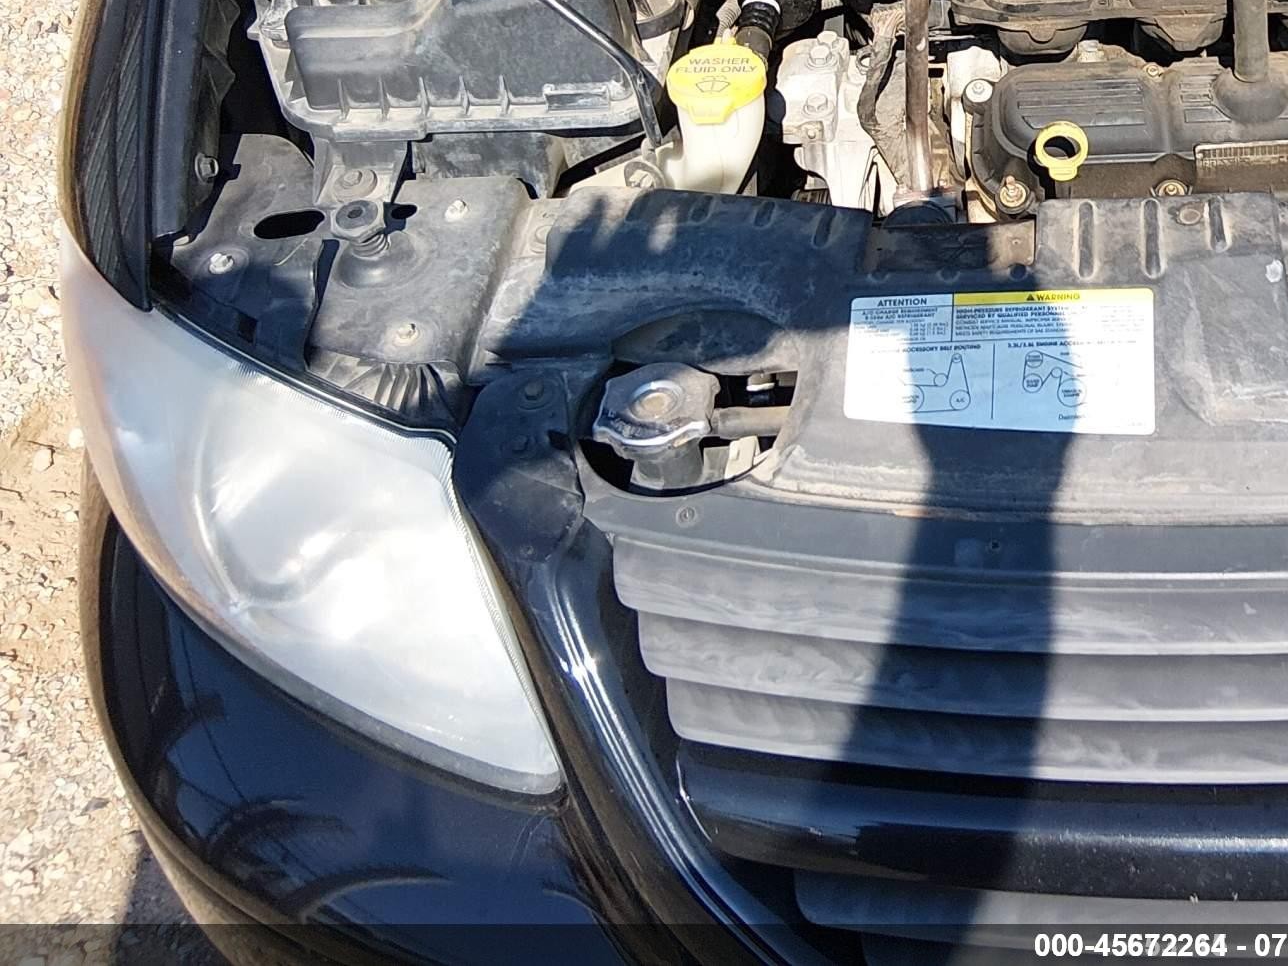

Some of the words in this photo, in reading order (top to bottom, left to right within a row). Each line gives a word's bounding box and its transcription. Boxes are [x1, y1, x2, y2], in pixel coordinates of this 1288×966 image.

[688, 57, 750, 66] WASHER
[675, 65, 717, 74] FLUID
[721, 65, 758, 74] ONLY
[1036, 293, 1081, 301] WARNING
[877, 298, 928, 308] ATTENTION
